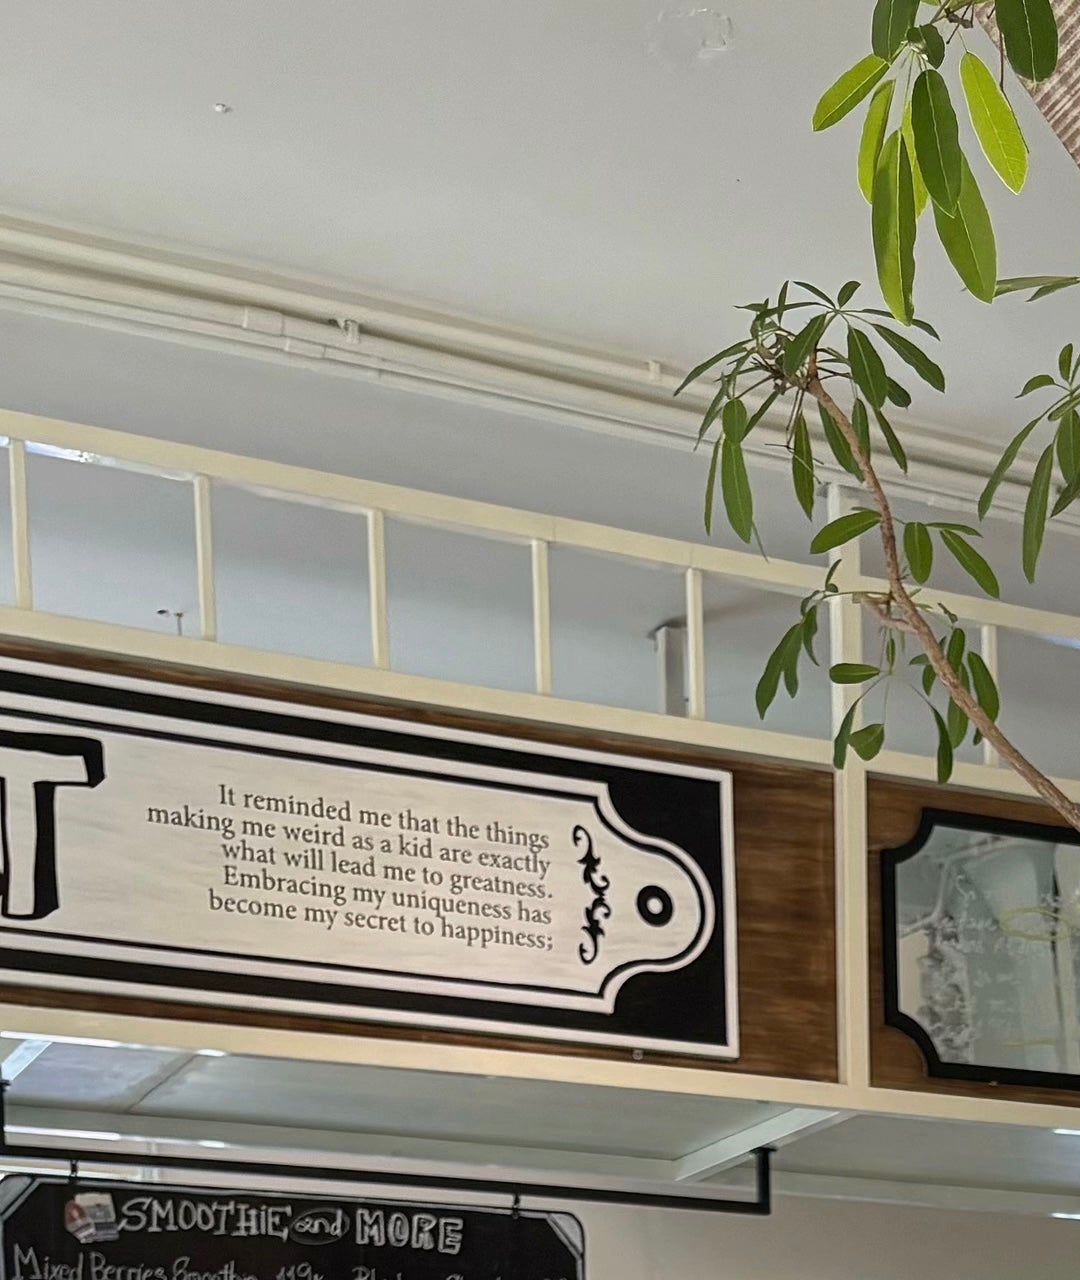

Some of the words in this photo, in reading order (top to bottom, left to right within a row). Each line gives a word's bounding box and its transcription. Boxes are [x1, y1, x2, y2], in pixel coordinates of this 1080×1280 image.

[148, 805, 235, 839] making
[242, 820, 276, 838] me
[283, 824, 345, 847] weird
[352, 835, 374, 851] as
[380, 839, 392, 853] a
[398, 834, 432, 859] kid
[439, 846, 472, 864] are
[478, 852, 551, 880] exactly
[218, 784, 235, 806] It
[244, 795, 351, 822] reminded
[359, 809, 392, 827] me
[398, 809, 440, 834] that
[446, 816, 480, 839] the
[486, 821, 550, 853] things
[221, 839, 276, 865] what
[284, 848, 323, 871] will
[331, 851, 376, 877] lead
[383, 865, 416, 882] me
[423, 866, 443, 885] to
[450, 873, 553, 899] greatness.
[223, 865, 347, 906] Embracing
[353, 886, 386, 910] my
[392, 891, 512, 921] uniqueness
[518, 900, 552, 924] has
[208, 888, 297, 919] become
[304, 905, 337, 931] my
[344, 911, 406, 933] secret
[414, 917, 434, 935] to
[441, 916, 553, 950] happiness;
[295, 1208, 343, 1236] and
[355, 1208, 464, 1254] MORE
